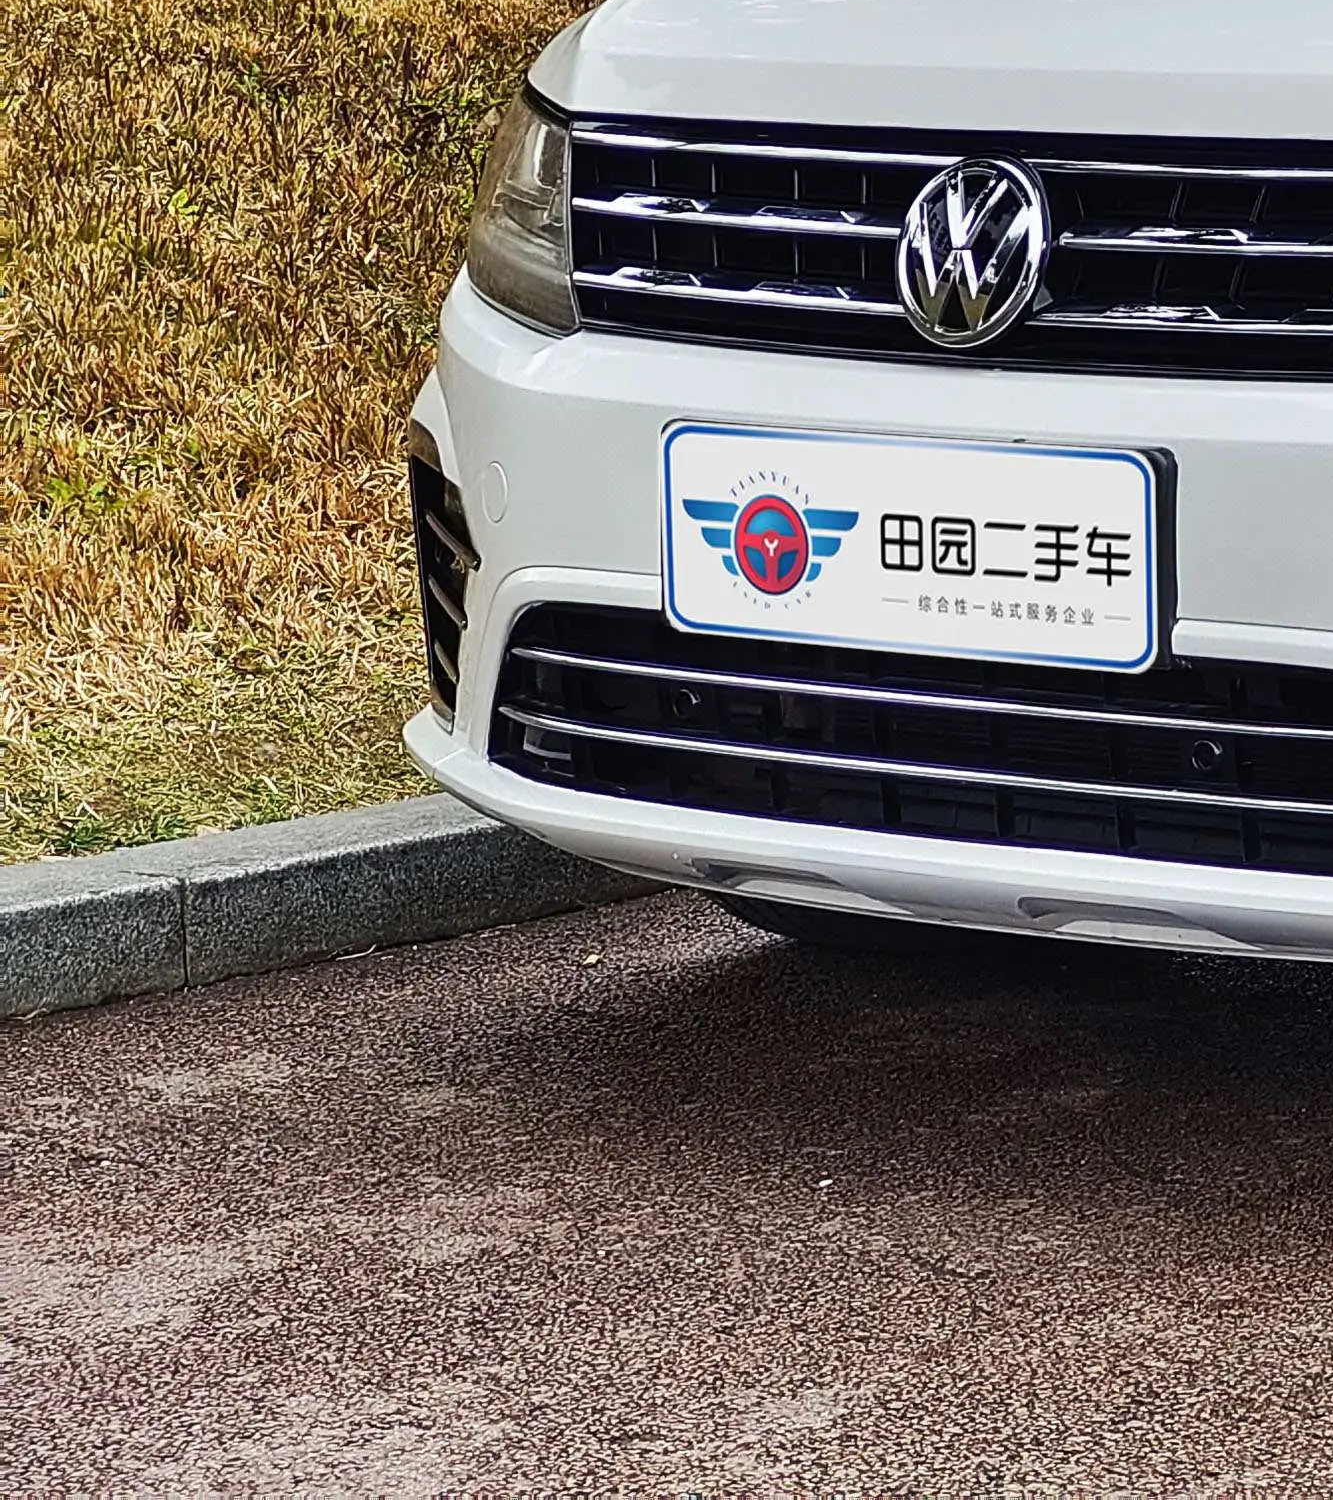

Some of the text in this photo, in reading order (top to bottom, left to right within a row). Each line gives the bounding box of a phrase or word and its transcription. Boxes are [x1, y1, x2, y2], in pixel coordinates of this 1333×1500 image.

[880, 513, 1133, 587] 田园二手车
[918, 594, 1096, 626] 综合性一站式服务企业
